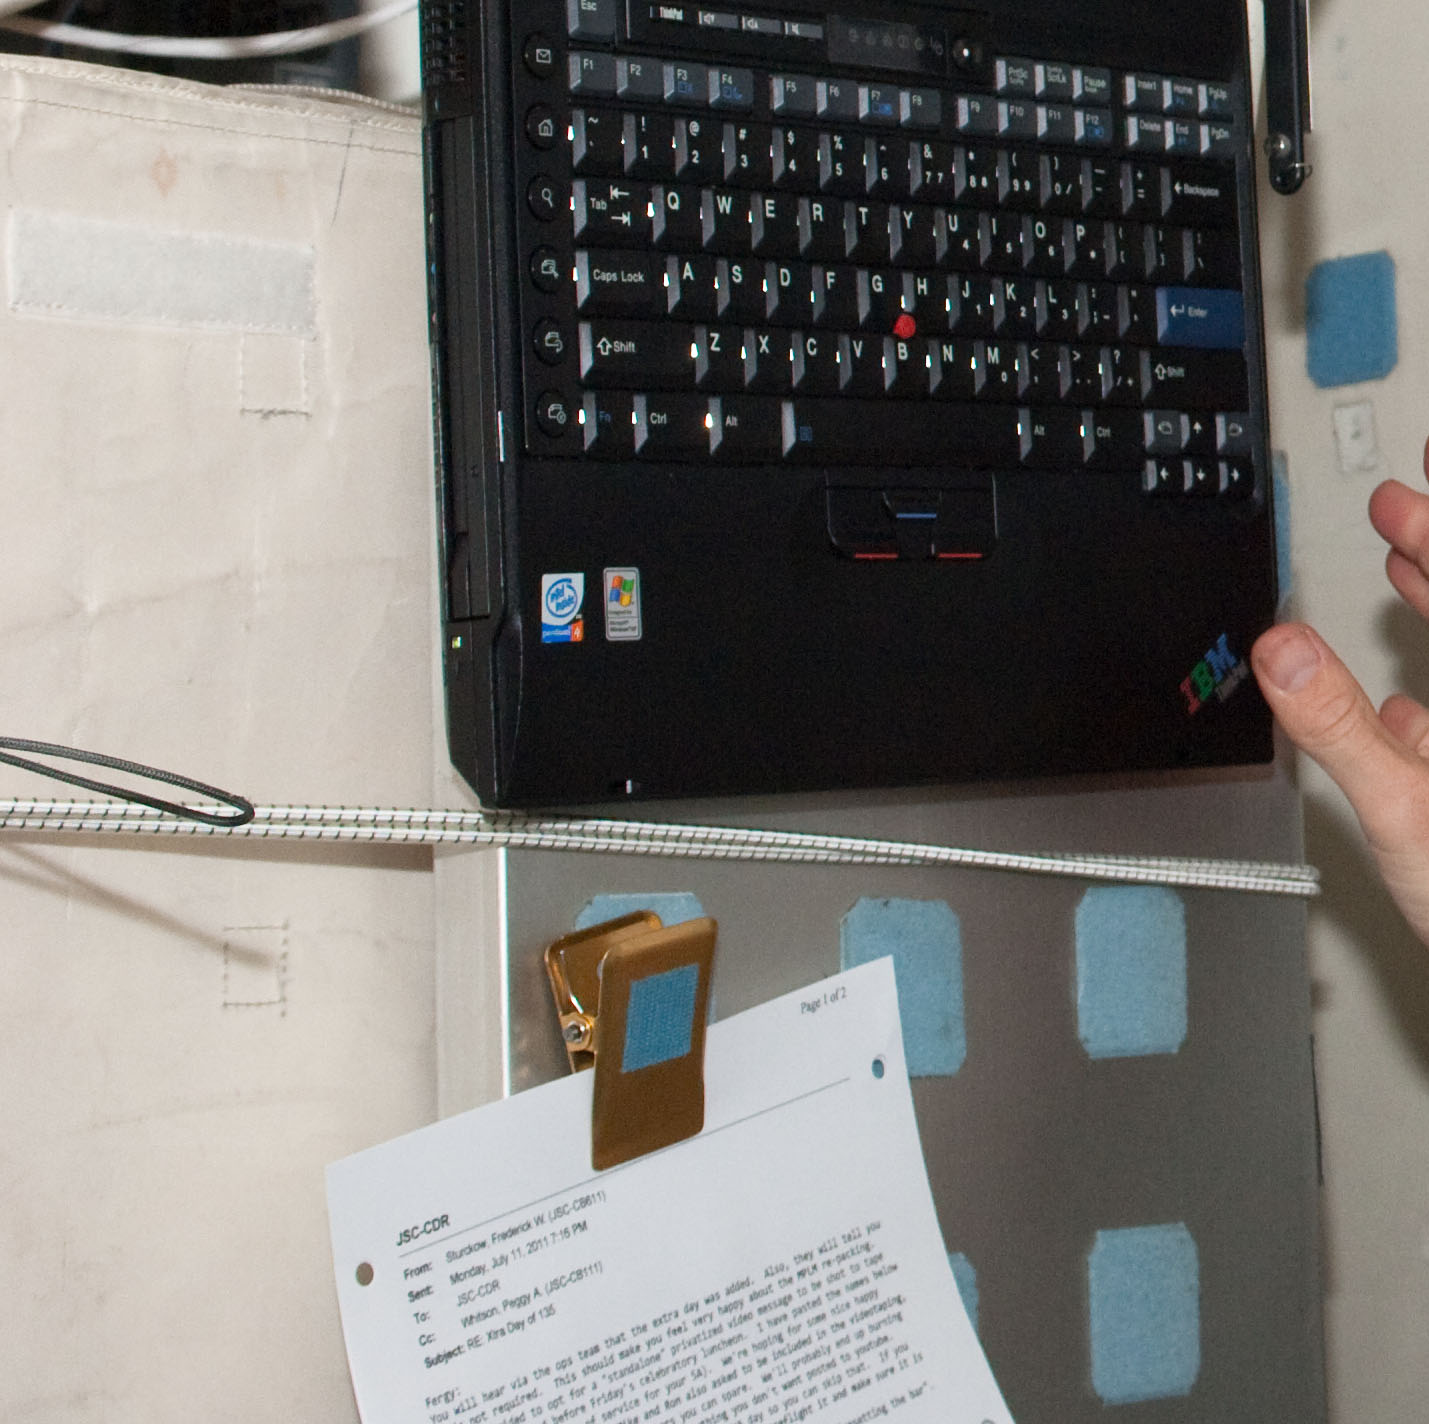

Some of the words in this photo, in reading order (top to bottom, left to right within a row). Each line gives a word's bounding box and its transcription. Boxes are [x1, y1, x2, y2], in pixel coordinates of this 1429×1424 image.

[581, 0, 597, 11] Esc
[583, 59, 594, 70] F1
[630, 63, 641, 76] F2
[677, 69, 688, 81] F3
[722, 74, 733, 85] F4
[786, 81, 797, 92] F5
[829, 85, 840, 97] F6
[871, 90, 881, 101] F7
[912, 95, 922, 106] F8
[1009, 105, 1024, 118] F10
[1048, 110, 1061, 121] F11
[1085, 114, 1099, 125] F12
[641, 145, 649, 160] 1
[691, 150, 700, 164] 2
[740, 154, 749, 167] 3
[788, 159, 796, 172] 4
[835, 163, 843, 176] 5
[881, 167, 888, 181] 6
[925, 171, 932, 183] 7
[590, 197, 608, 211] Tab
[667, 192, 680, 211] Q
[716, 195, 733, 215] W
[765, 200, 776, 218] E
[812, 203, 823, 223] R
[858, 207, 869, 226] T
[903, 211, 913, 230] Y
[948, 214, 959, 232] U
[1035, 221, 1046, 239] O
[1076, 224, 1086, 242] P
[593, 269, 617, 283] Caps
[621, 270, 645, 284] Lock
[682, 261, 695, 280] A
[731, 265, 743, 284] S
[780, 268, 791, 287] D
[826, 271, 836, 290] F
[871, 275, 884, 293] G
[917, 278, 928, 296] H
[962, 280, 970, 298] J
[1006, 283, 1017, 302] K
[1049, 287, 1057, 304] L
[613, 340, 636, 354] Shift
[710, 332, 721, 352] Z
[759, 335, 770, 354] X
[806, 337, 817, 356] C
[853, 340, 863, 359] V
[898, 342, 908, 360] B
[942, 344, 954, 363] N
[987, 347, 1000, 365] M
[650, 412, 667, 425] Ctrl
[725, 414, 738, 427] Alt
[800, 997, 821, 1014] Page
[396, 1214, 450, 1246] JSC-CDR
[403, 1261, 433, 1280] From:
[407, 1285, 434, 1303] Sent:
[492, 1254, 509, 1270] July
[526, 1236, 549, 1254] 2011
[572, 1220, 588, 1236] PM
[413, 1311, 431, 1325] To:
[456, 1279, 501, 1308] JSC-CDR
[533, 1366, 550, 1380] the
[555, 1356, 573, 1371] ops
[578, 1344, 600, 1360] team
[604, 1332, 626, 1349] that
[631, 1323, 648, 1337] the
[652, 1310, 679, 1328] extra
[684, 1301, 700, 1315] day
[866, 1220, 881, 1235] you
[418, 1333, 437, 1347] Cc:
[502, 1292, 531, 1311] Peggy
[581, 1354, 615, 1377] should
[645, 1336, 662, 1351] you
[718, 1298, 744, 1315] happy
[749, 1284, 774, 1302] about
[778, 1276, 793, 1289] the
[424, 1344, 467, 1369] Subject:
[506, 1318, 526, 1335] Day
[527, 1311, 538, 1324] of
